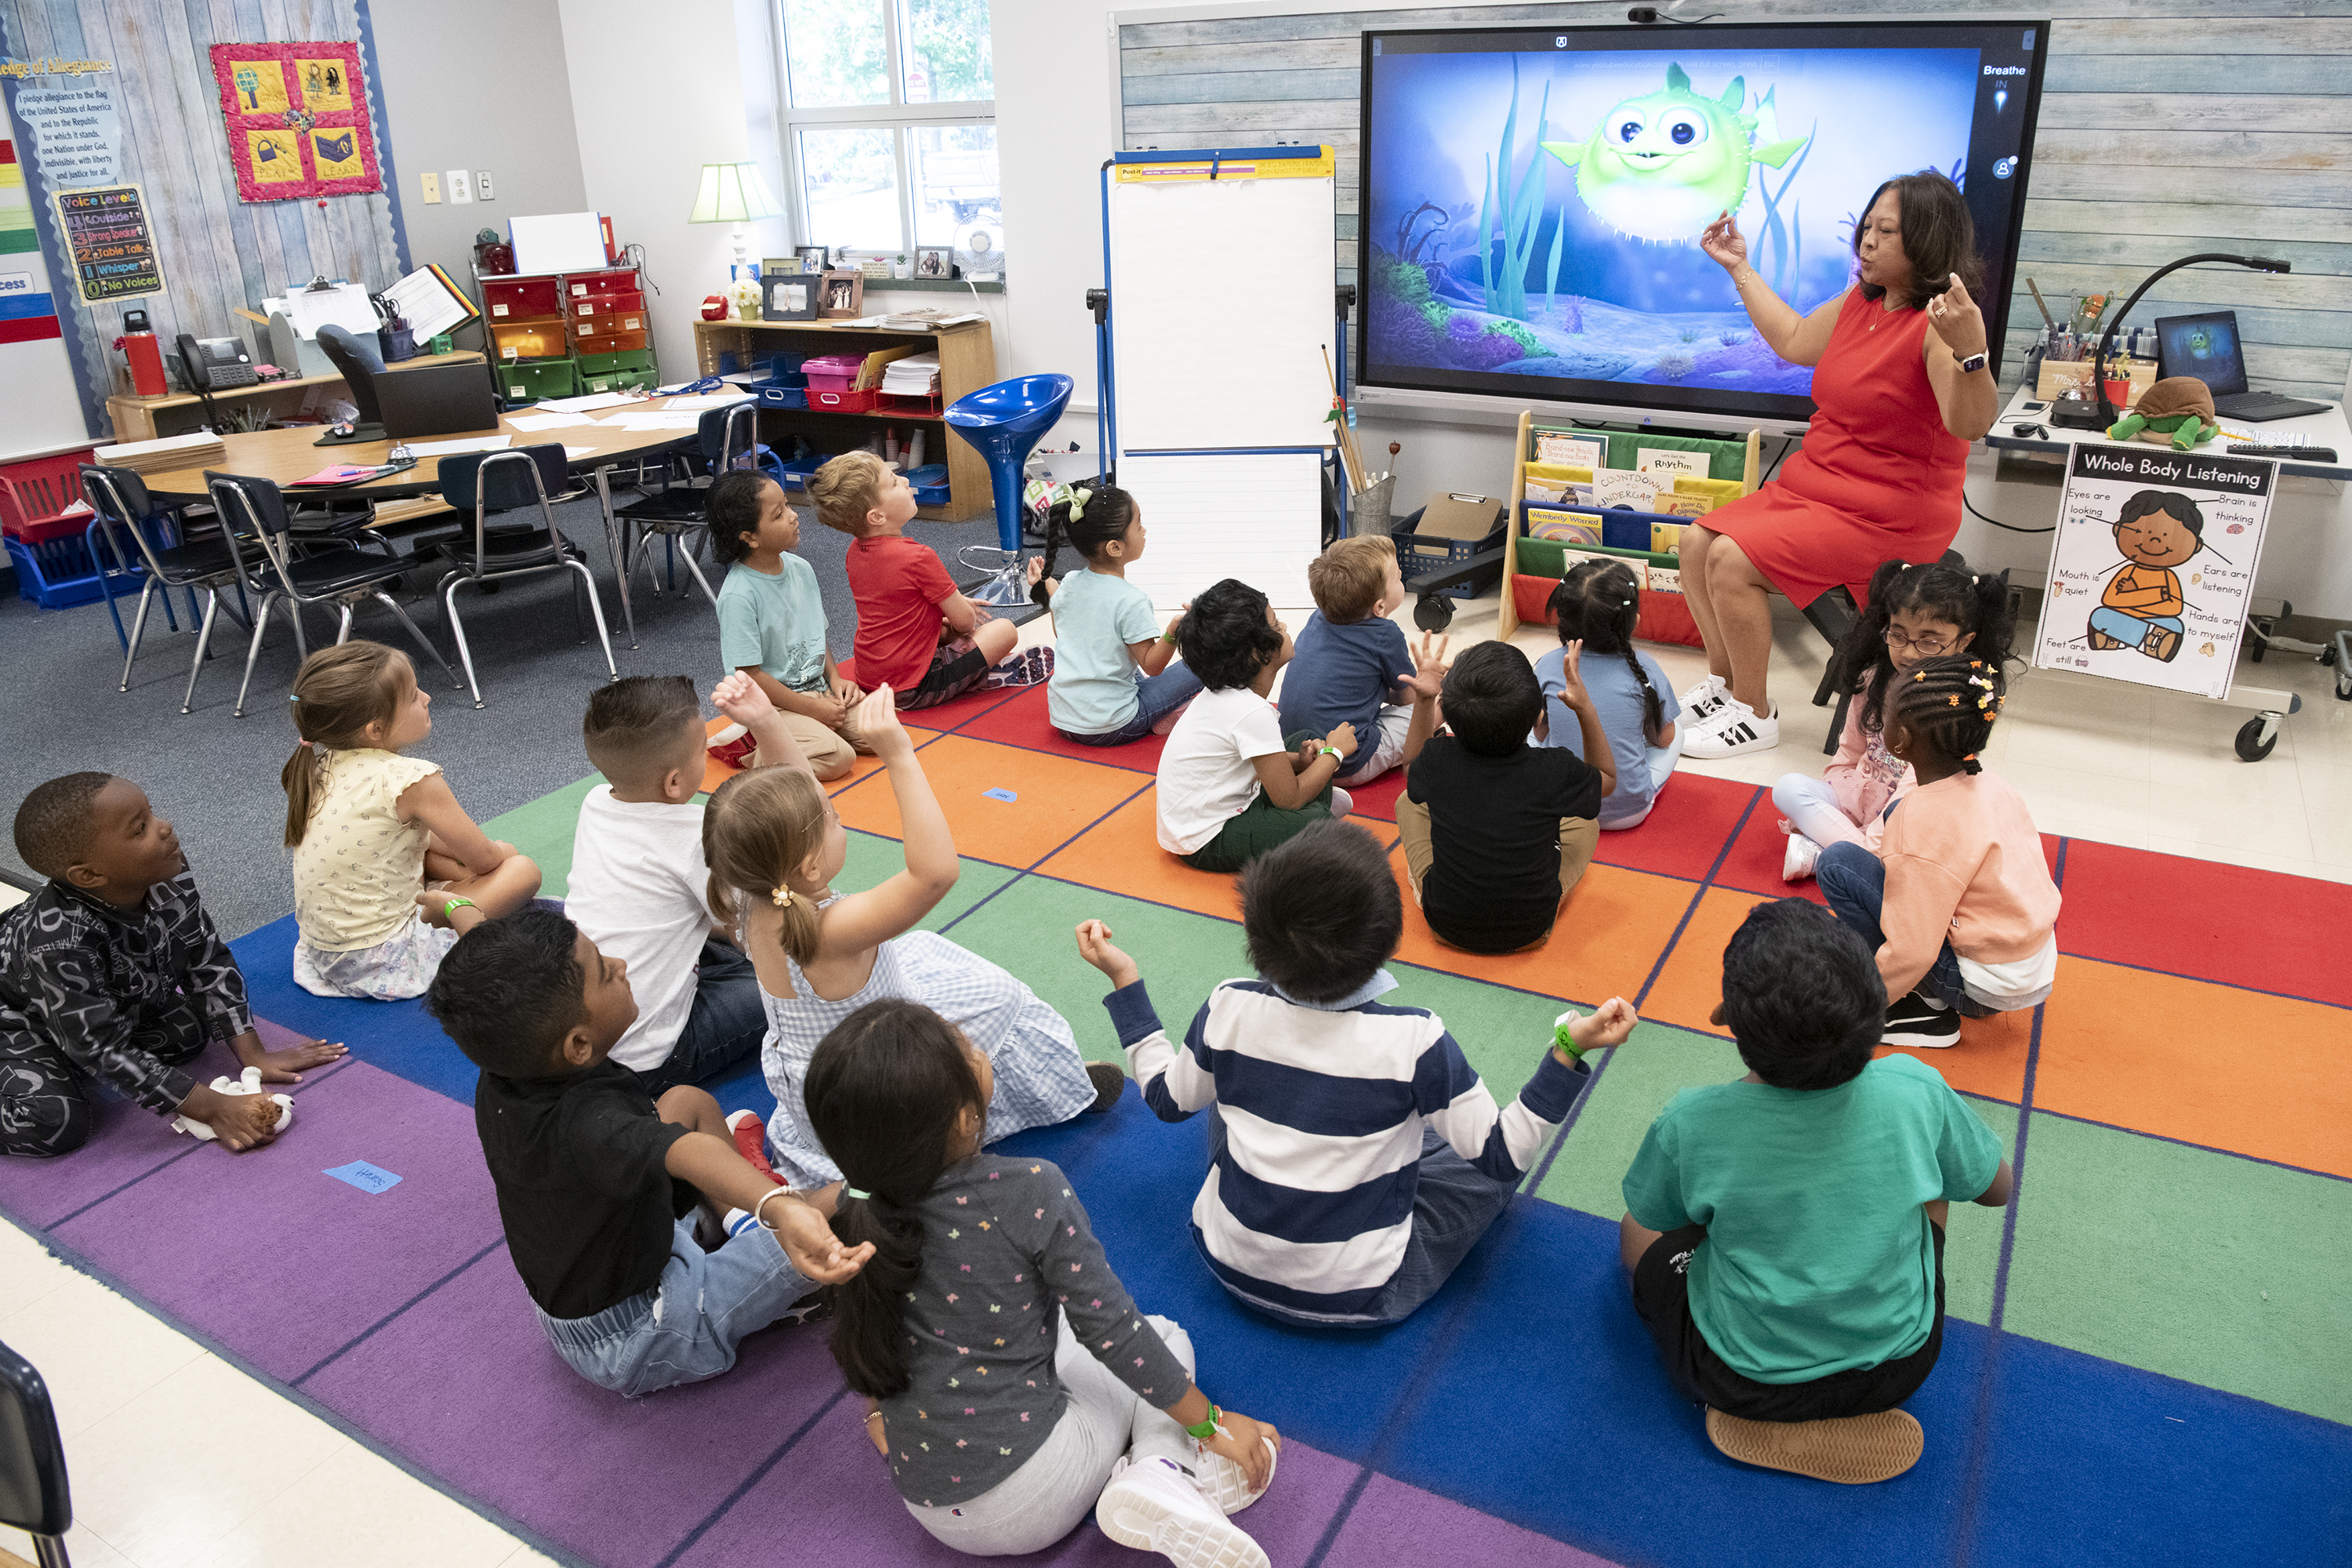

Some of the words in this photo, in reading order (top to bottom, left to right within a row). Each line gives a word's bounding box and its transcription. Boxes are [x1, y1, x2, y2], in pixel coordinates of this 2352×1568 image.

[32, 58, 44, 74] of
[48, 56, 112, 78] Allegiance
[1984, 66, 2026, 75] Breathe
[1995, 80, 2008, 89] IN
[23, 93, 43, 103] pledge
[44, 91, 75, 103] allegiance
[84, 90, 94, 99] the
[95, 90, 107, 100] flag
[27, 107, 37, 116] the
[38, 106, 58, 115] United
[59, 104, 78, 114] States
[86, 103, 112, 112] America
[41, 120, 54, 129] and
[72, 117, 99, 127] Republic
[43, 132, 53, 141] for
[53, 132, 72, 140] which
[79, 131, 101, 140] stands,
[54, 145, 75, 154] Nation
[76, 144, 94, 153] under
[94, 142, 109, 151] God,
[44, 158, 78, 168] indivisible,
[78, 157, 92, 165] with
[93, 155, 112, 165] liberty
[68, 170, 89, 180] justice
[89, 169, 99, 177] for
[100, 168, 110, 176] all.
[260, 169, 286, 178] PLAY
[323, 166, 358, 177] LEARN
[64, 196, 98, 208] Voice
[100, 192, 136, 205] Levels
[68, 216, 84, 229] 4
[91, 212, 129, 224] Outside
[73, 232, 88, 245] 3
[89, 232, 111, 241] Strong
[111, 228, 137, 241] Speaker
[77, 248, 93, 262] 2
[97, 247, 124, 257] Table
[125, 244, 145, 254] Talk
[85, 265, 94, 278] 1
[98, 263, 140, 274] Whisper
[88, 281, 100, 296] 0
[107, 281, 122, 290] No
[123, 277, 158, 288] Voices
[1575, 452, 1590, 461] Books
[1655, 459, 1692, 470] Rhythm
[2085, 453, 2134, 472] Whole
[2140, 459, 2181, 481] Body
[2186, 464, 2260, 489] Listening
[1600, 474, 1664, 492] COUNTDOWN
[1595, 490, 1656, 509] KINDERGART
[2068, 488, 2091, 500] Eyes
[2093, 492, 2111, 501] are
[2218, 495, 2247, 506] Brain
[2249, 499, 2257, 508] is
[1676, 508, 1707, 517] Dinosaur
[2070, 504, 2103, 517] looking
[1530, 511, 1568, 523] Wemberly
[1569, 514, 1599, 525] Worried
[2215, 510, 2254, 526] thinking
[2059, 568, 2090, 581] Mouth
[2092, 572, 2100, 582] is
[2203, 564, 2227, 578] Ears
[2229, 570, 2249, 580] are
[2064, 586, 2089, 597] quiet
[2202, 581, 2242, 597] listening
[2189, 610, 2220, 626] Hands
[2222, 617, 2240, 626] are
[2187, 626, 2197, 636] to
[2200, 630, 2236, 643] myself
[2046, 637, 2067, 649] Feet
[2070, 642, 2086, 652] are
[2056, 655, 2072, 665] still
